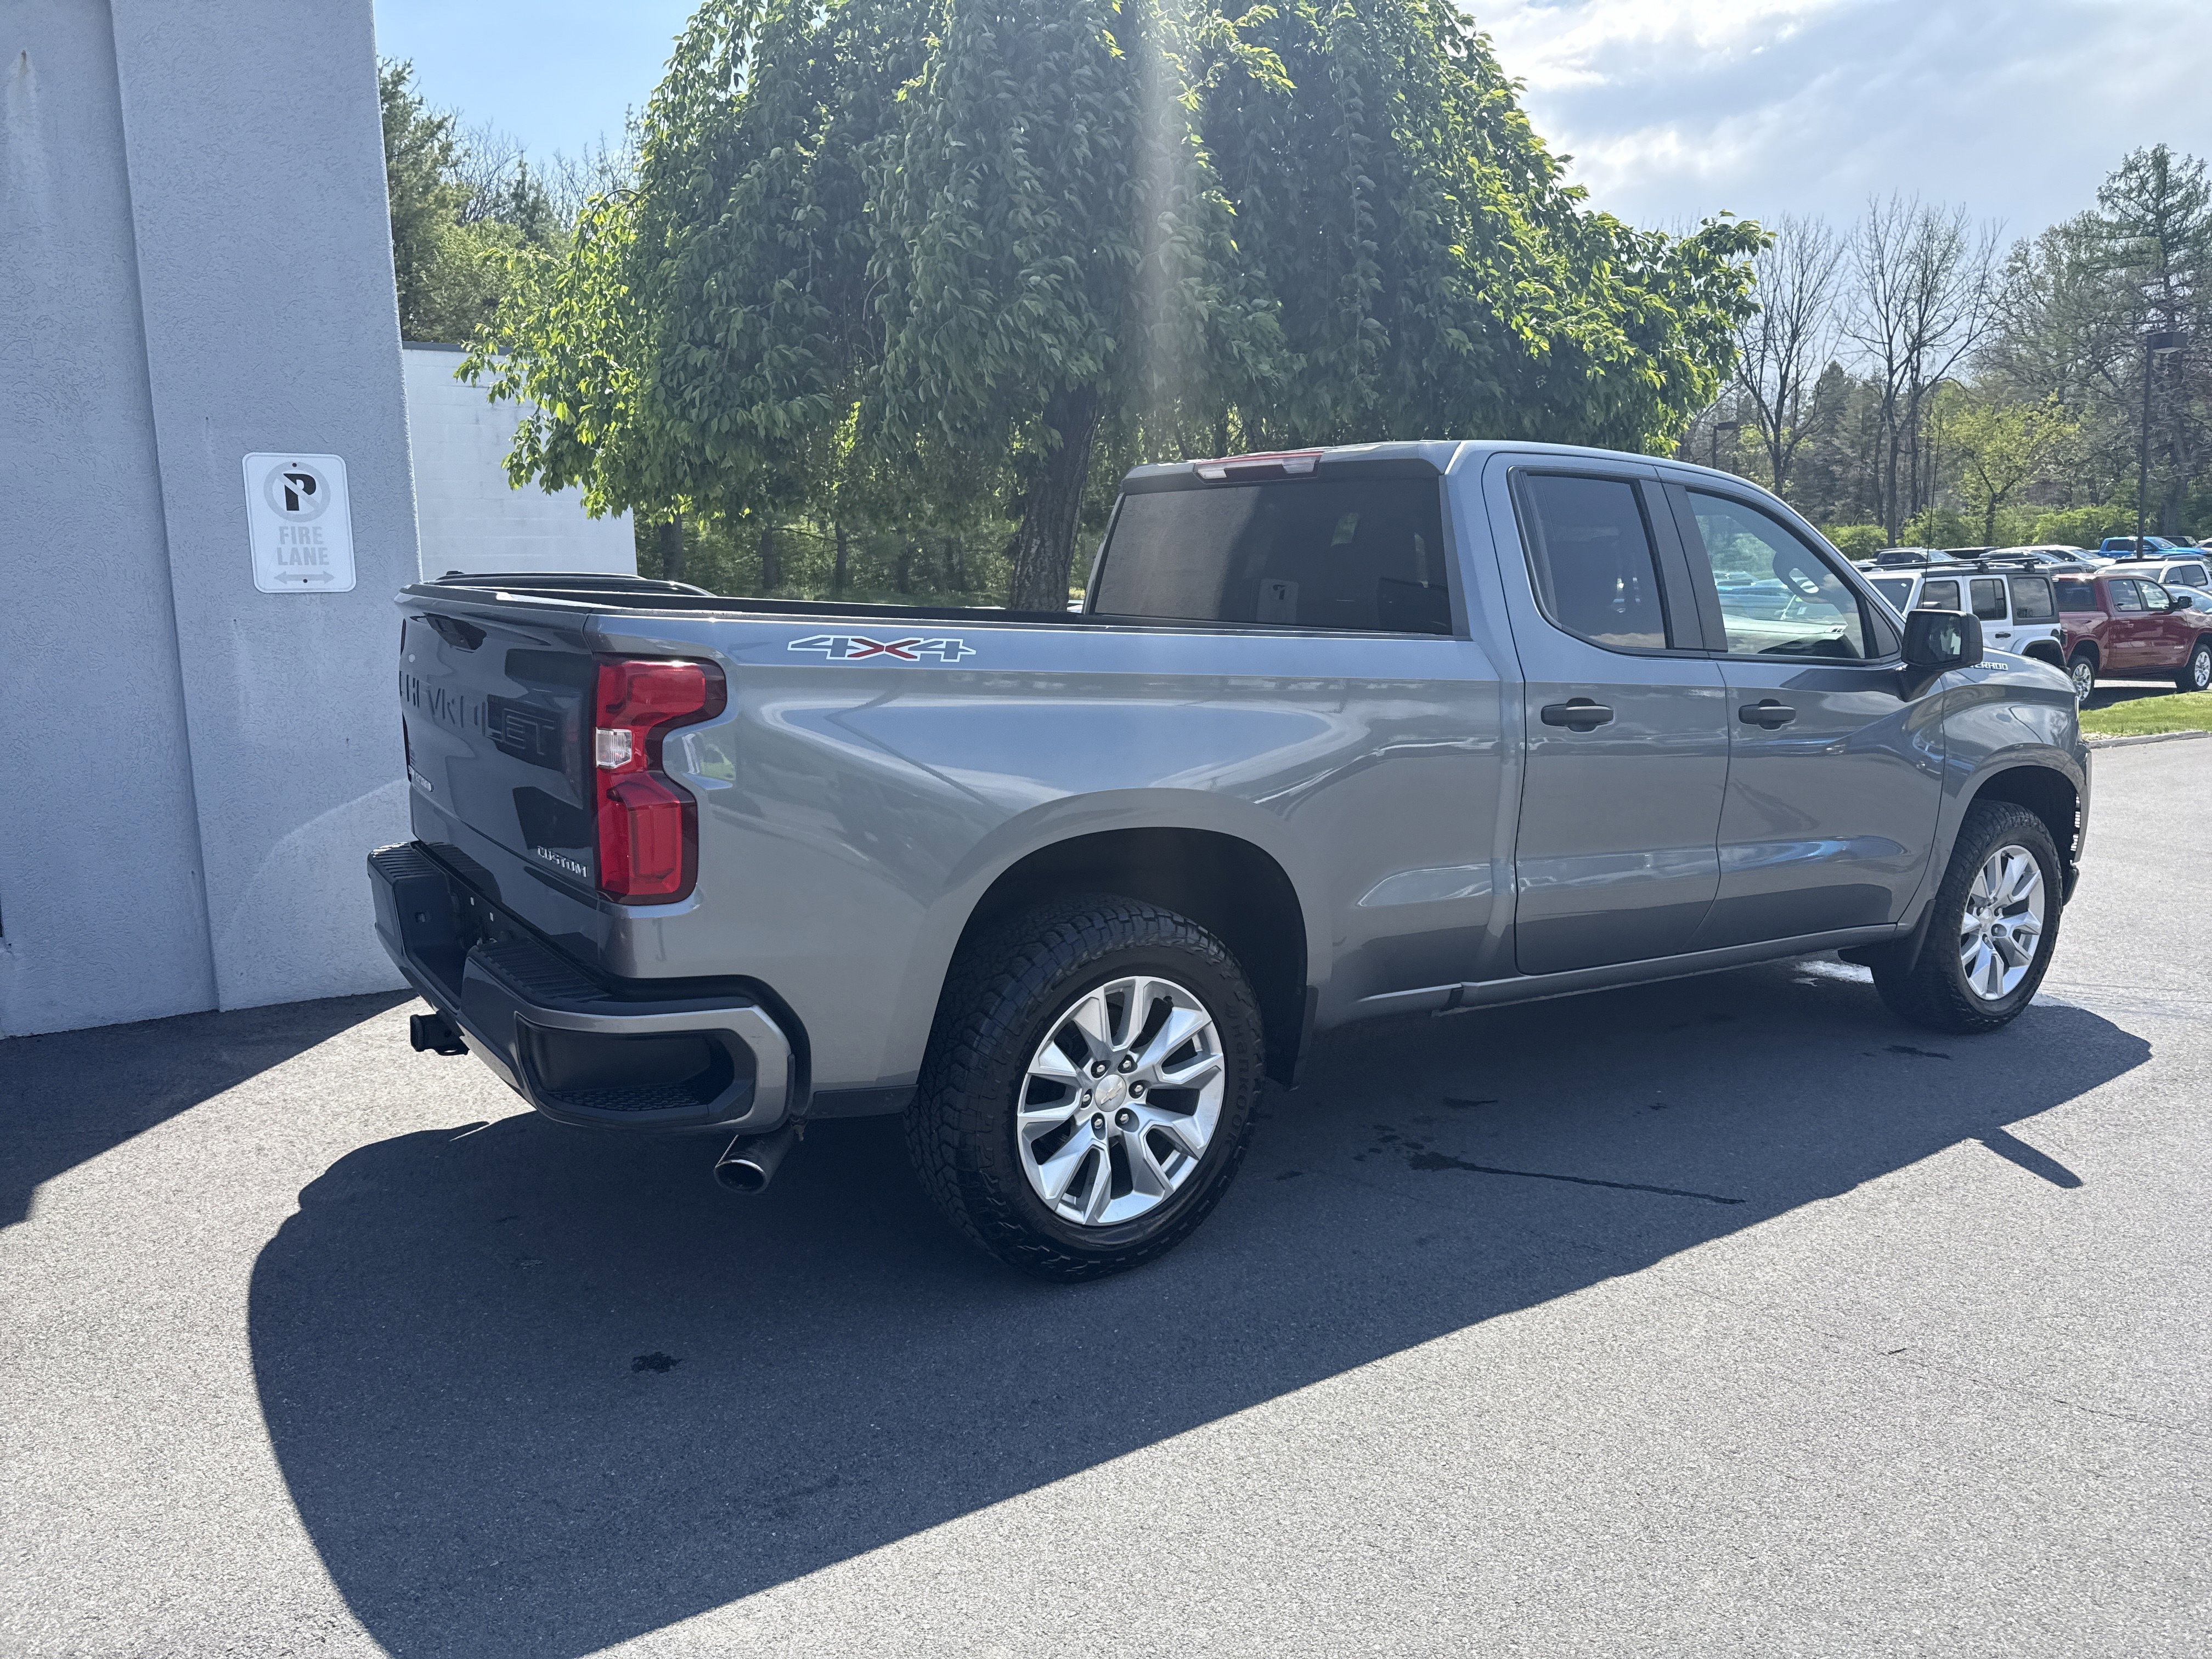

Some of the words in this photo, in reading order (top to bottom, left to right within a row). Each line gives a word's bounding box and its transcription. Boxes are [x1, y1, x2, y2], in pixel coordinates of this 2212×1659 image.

[283, 473, 317, 511] P
[279, 526, 324, 545] FIRE
[276, 547, 329, 566] LANE
[1970, 661, 2008, 670] ERADO
[538, 845, 587, 878] CUSTOM
